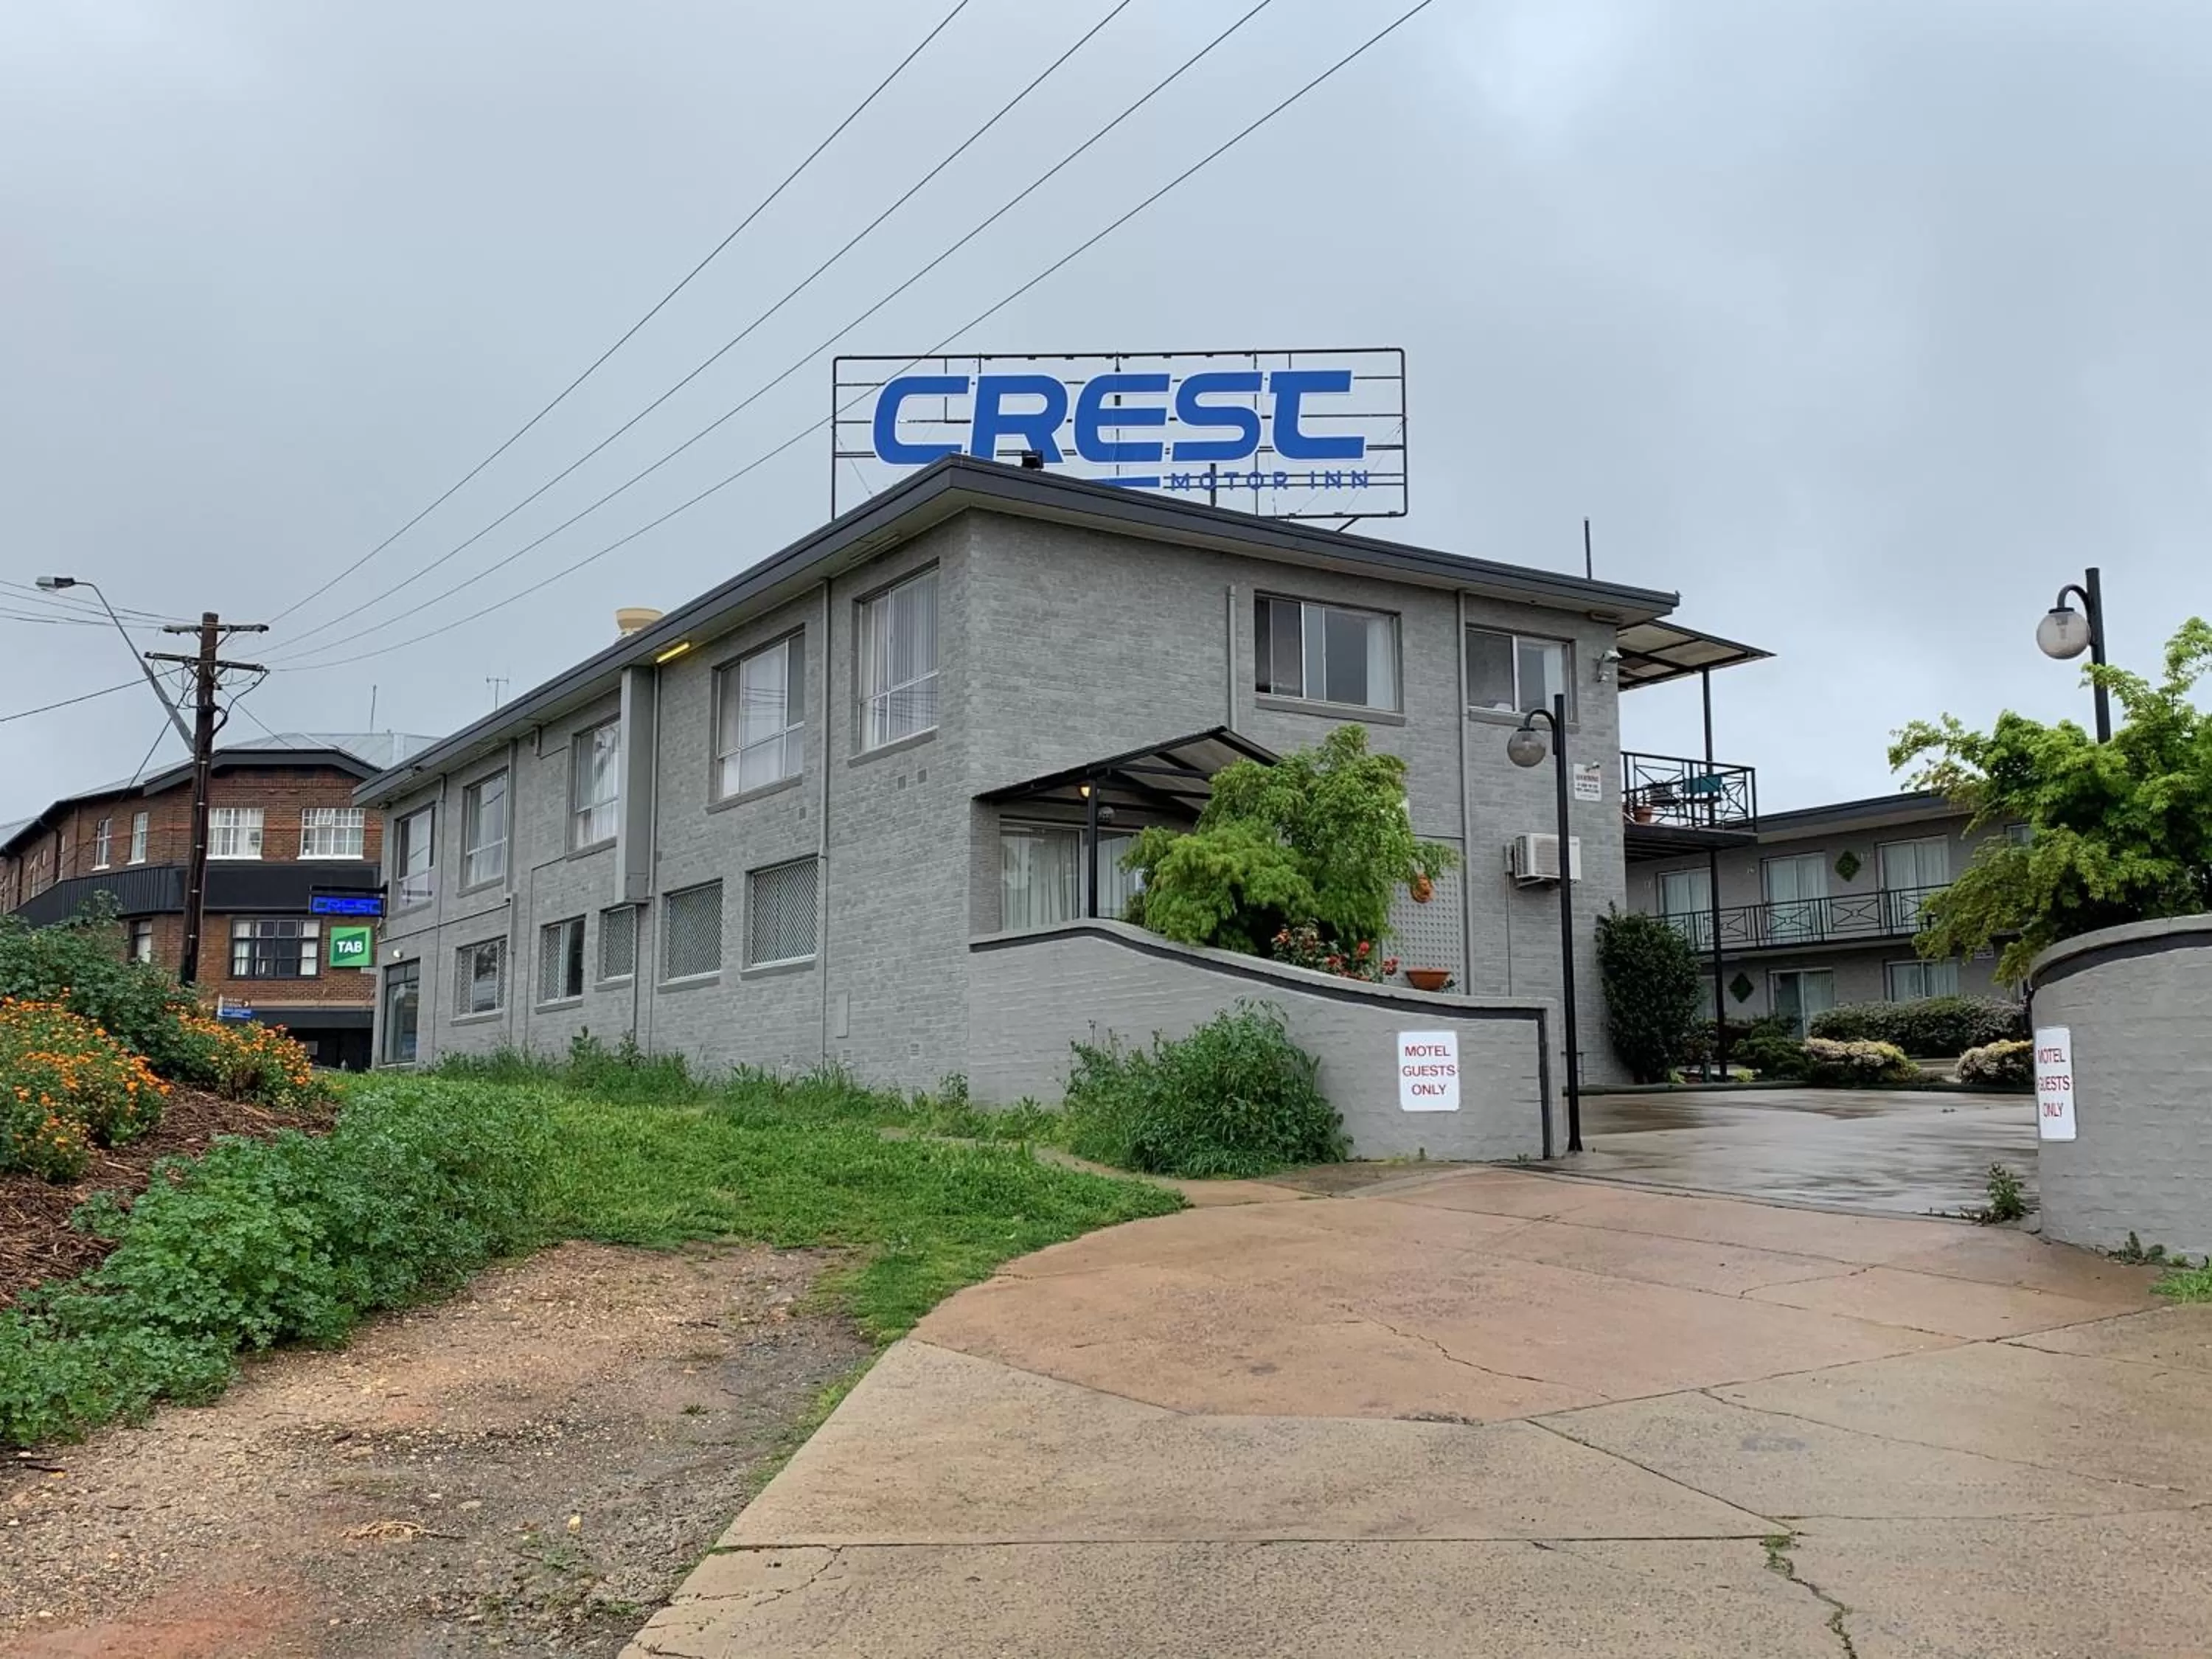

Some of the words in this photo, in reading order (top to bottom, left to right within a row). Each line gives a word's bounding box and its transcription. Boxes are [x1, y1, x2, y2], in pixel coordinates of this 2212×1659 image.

[874, 369, 1366, 465] CREST
[1169, 471, 1289, 491] MOTOR
[1310, 469, 1368, 490] INN
[337, 940, 364, 953] TAB
[1405, 1045, 1451, 1057] MOTEL
[2037, 1048, 2067, 1064] MOTEL
[1402, 1064, 1456, 1077] GUESTS
[1411, 1084, 1447, 1096] ONLY
[2039, 1075, 2070, 1092] GUESTS
[2043, 1102, 2064, 1118] ONLY
